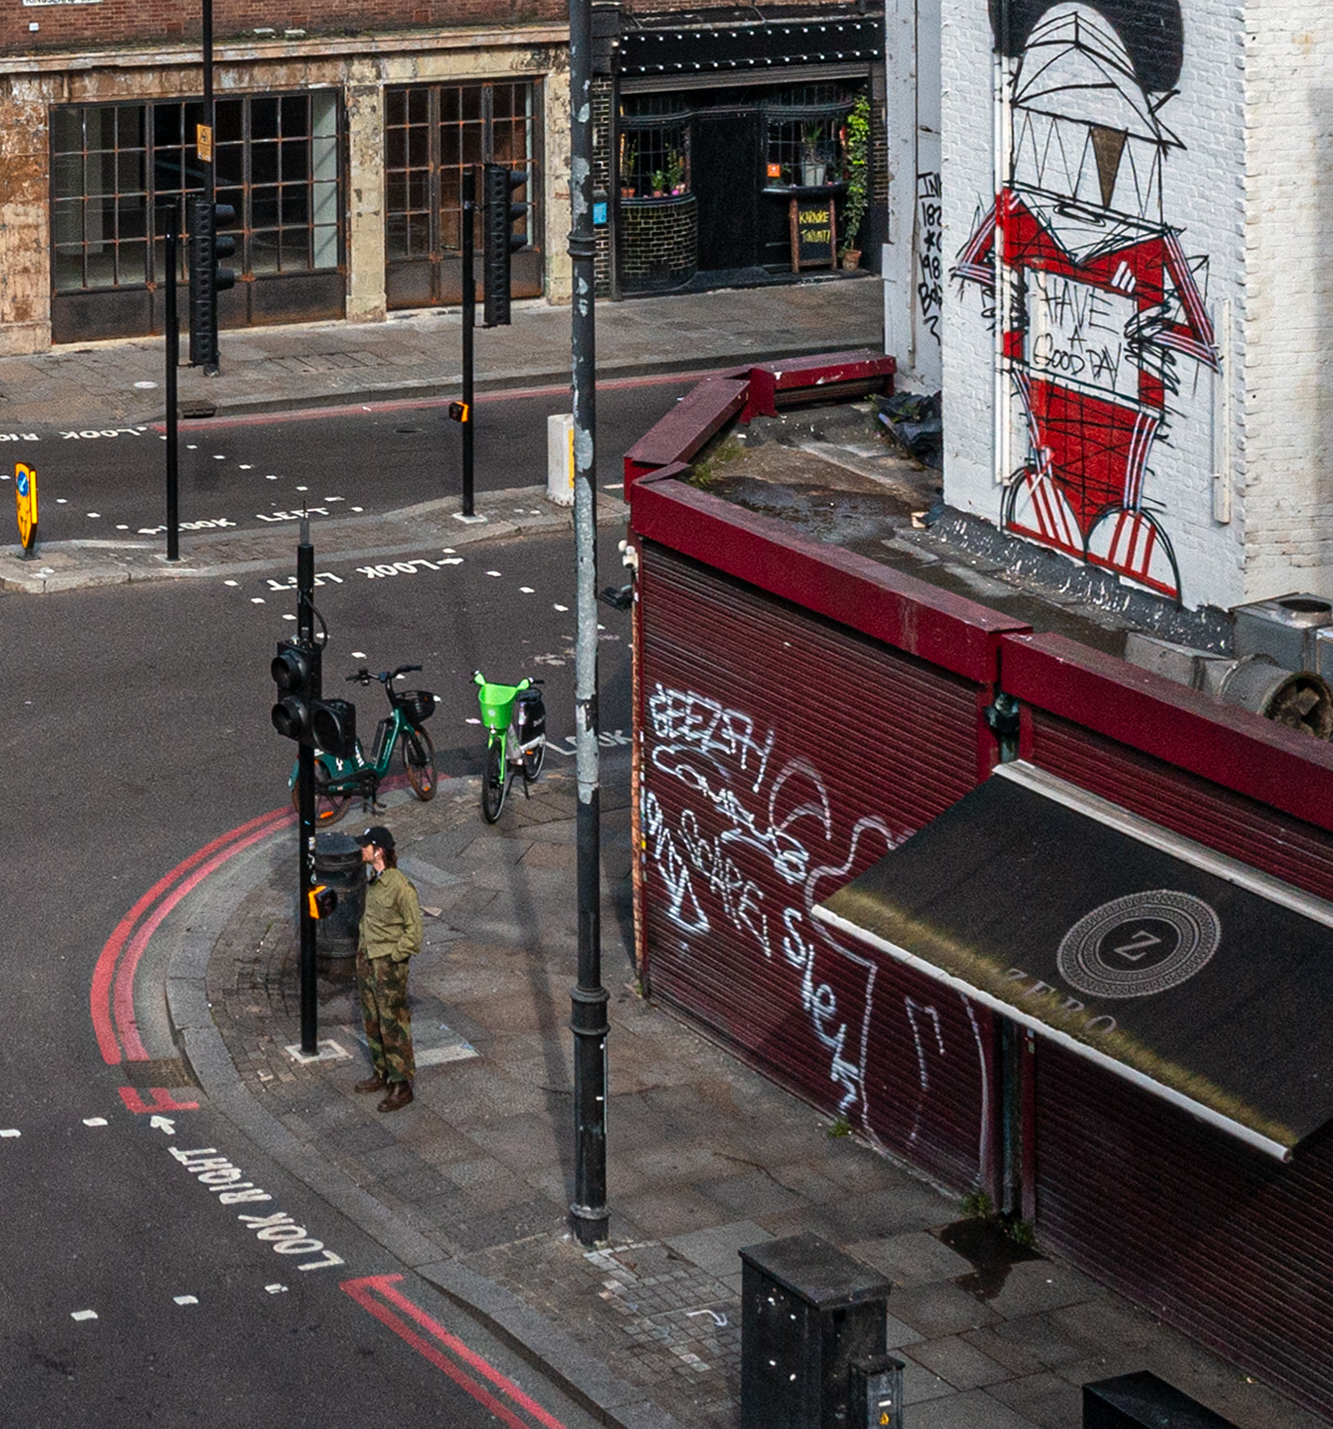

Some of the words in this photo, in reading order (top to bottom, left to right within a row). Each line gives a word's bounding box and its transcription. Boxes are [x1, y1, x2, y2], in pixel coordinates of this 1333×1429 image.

[1035, 274, 1119, 335] HAVE
[1067, 325, 1087, 354] A
[1034, 333, 1085, 375] GOOD
[1086, 342, 1122, 392] DAY
[60, 428, 141, 439] LOOK
[256, 507, 330, 522] LEFT
[356, 558, 441, 579] LOOK
[1113, 930, 1162, 962] Z
[167, 1146, 272, 1205] RIGHT
[237, 1212, 345, 1271] LOOK
